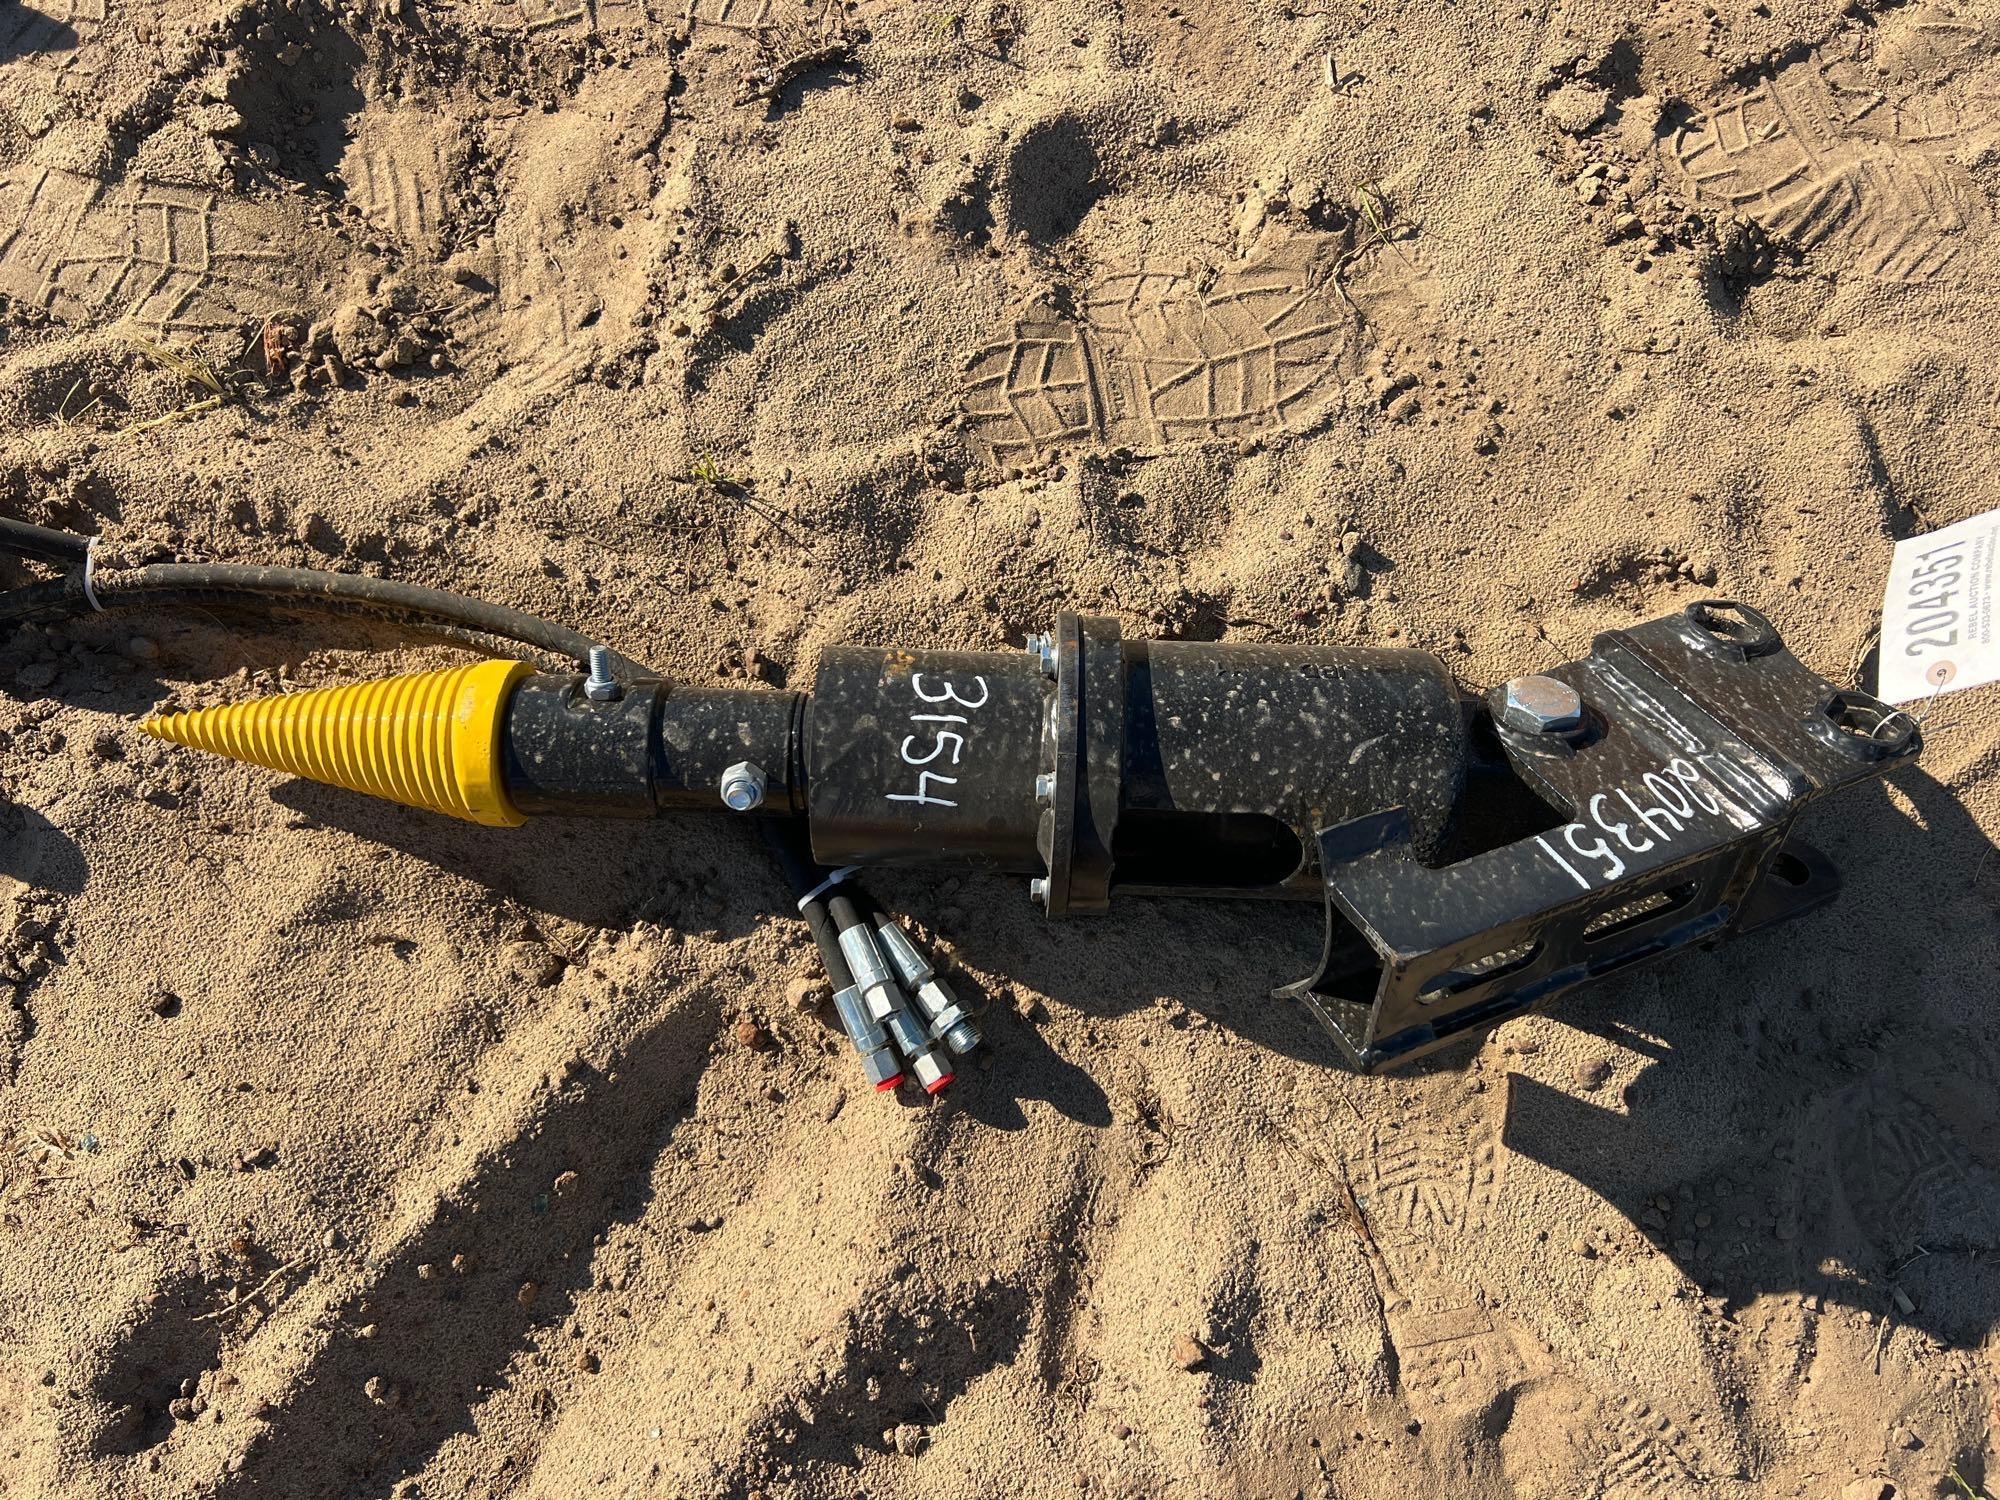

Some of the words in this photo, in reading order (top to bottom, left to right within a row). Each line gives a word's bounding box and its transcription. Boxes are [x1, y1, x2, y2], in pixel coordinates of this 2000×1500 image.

[1968, 571, 1980, 609] AUCTION
[1971, 536, 1985, 571] COMPANY
[1905, 541, 1966, 656] 204351
[1967, 610, 1978, 640] REBEL
[885, 673, 989, 806] 3154
[1535, 757, 1720, 889] 204351
